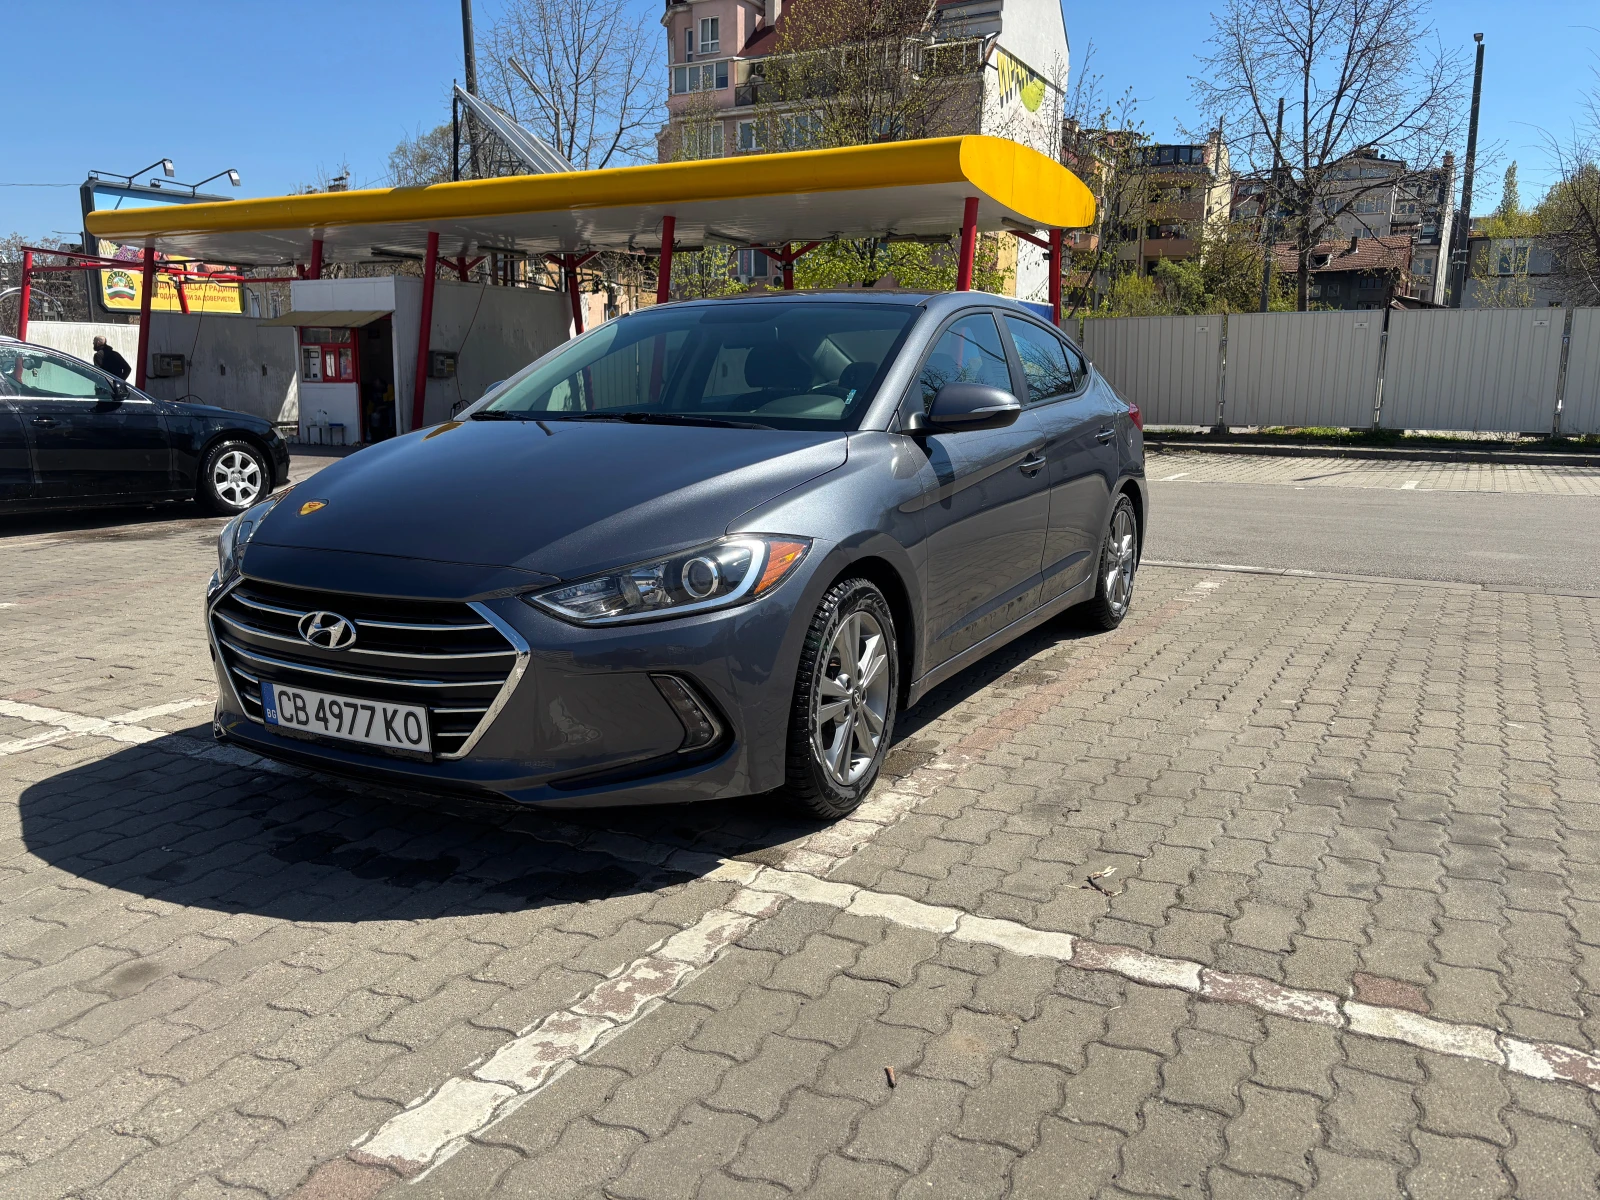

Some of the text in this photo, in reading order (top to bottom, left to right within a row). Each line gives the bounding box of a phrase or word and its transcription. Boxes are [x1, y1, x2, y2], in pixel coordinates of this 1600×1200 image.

[266, 708, 277, 719] BG
[277, 690, 423, 745] CB 4977 KO
